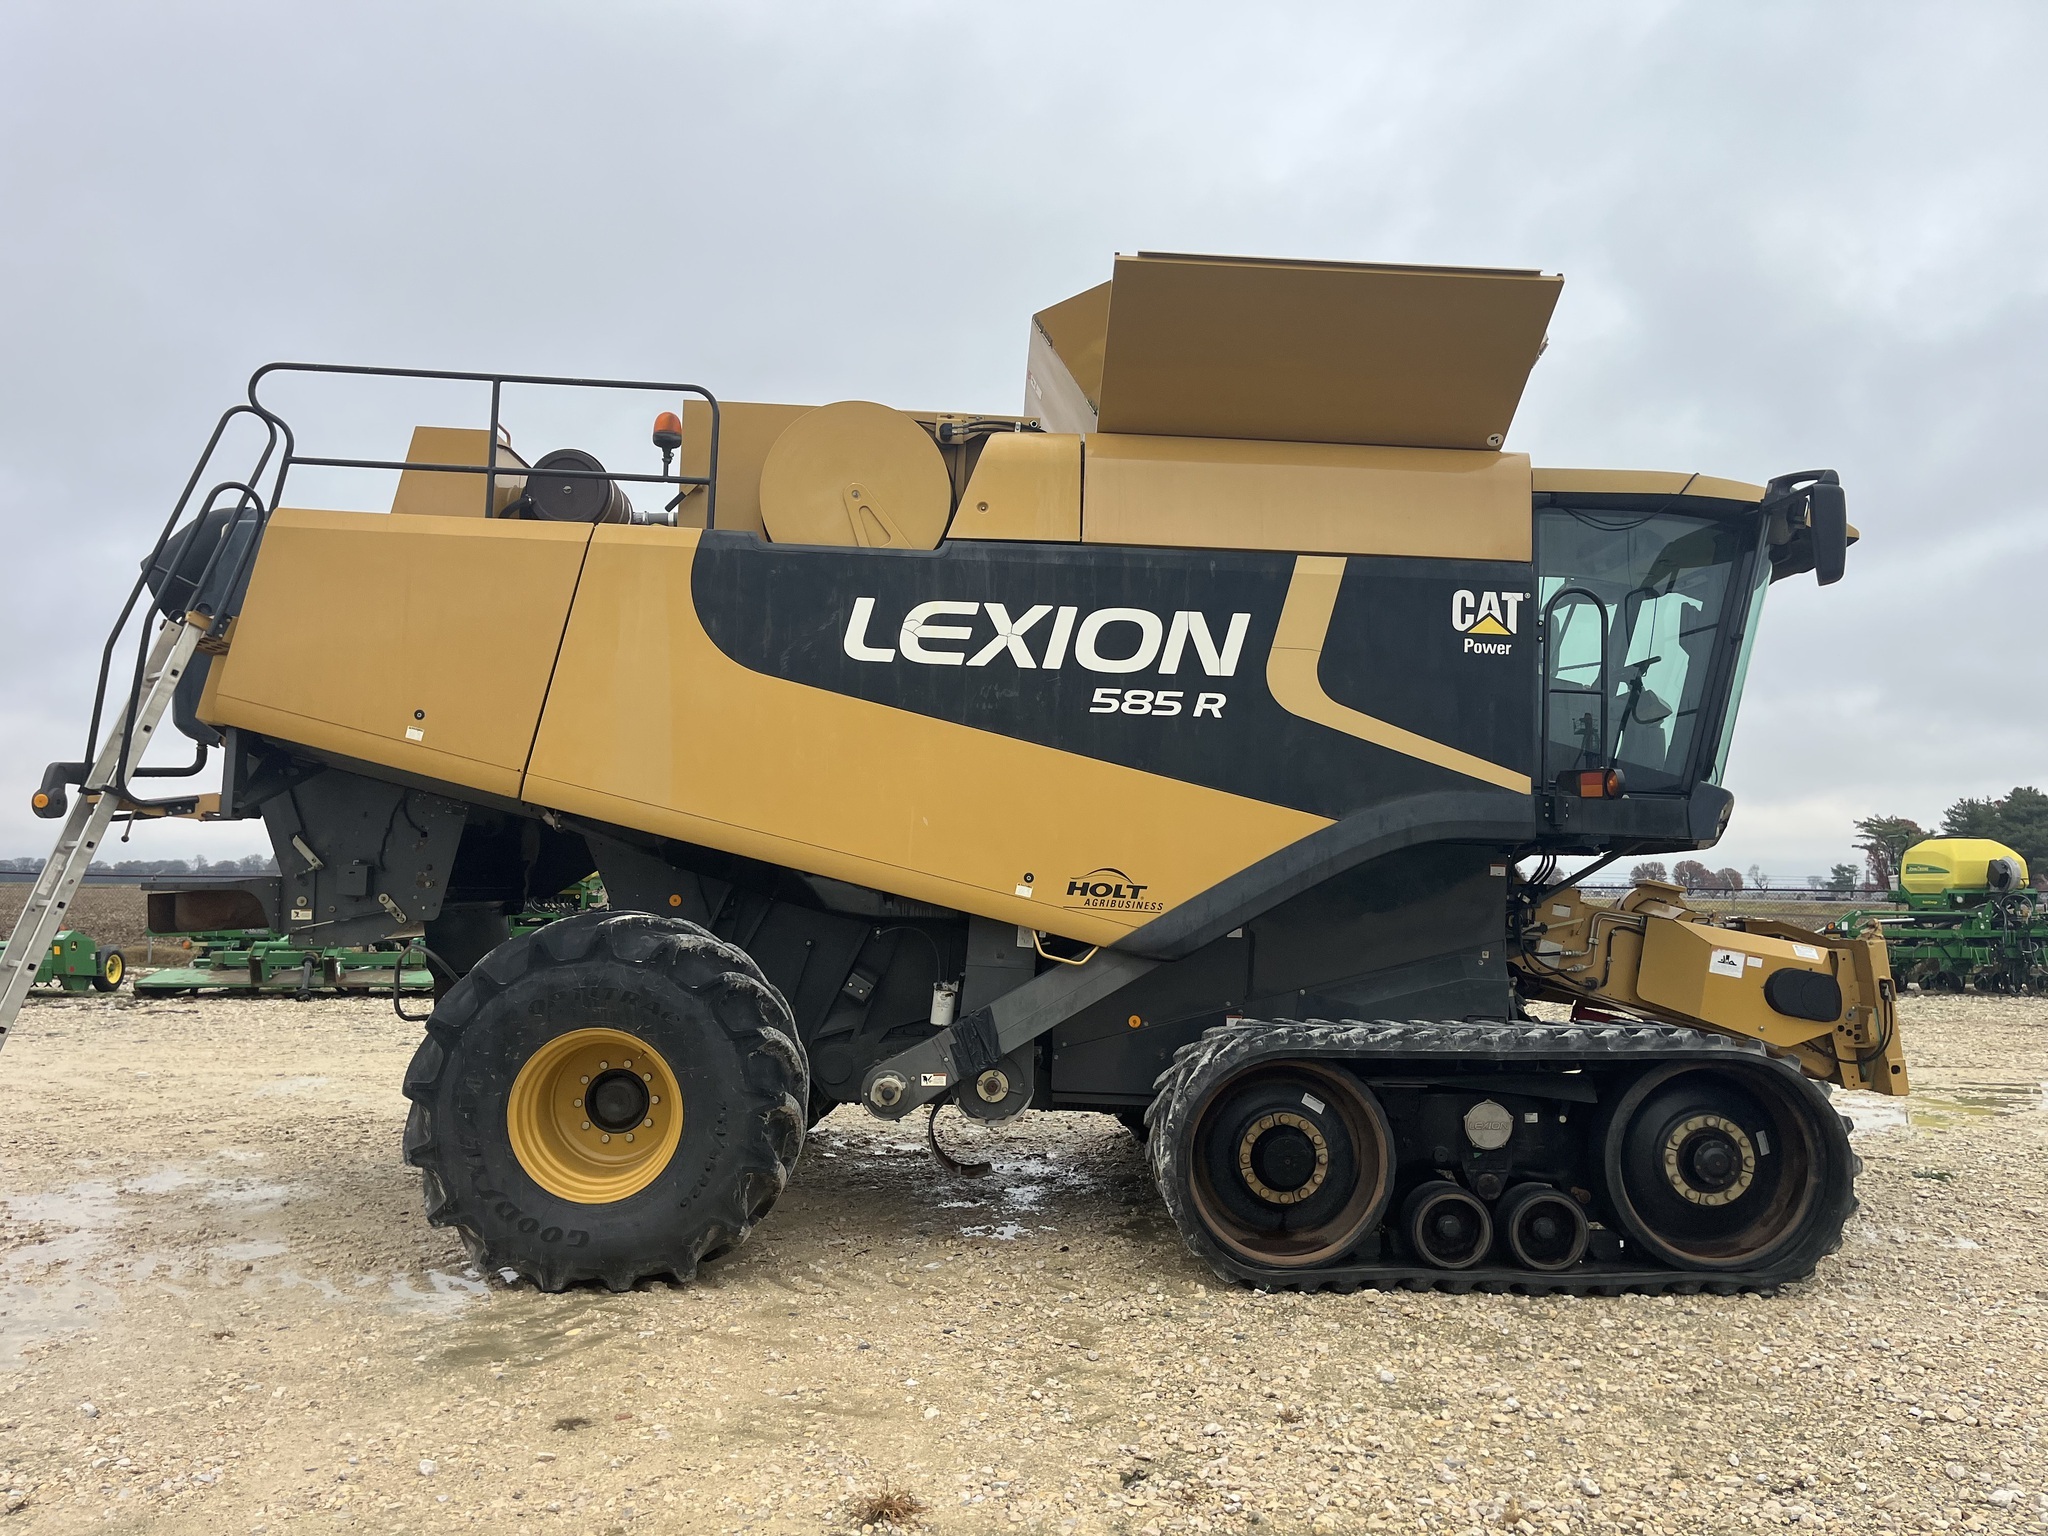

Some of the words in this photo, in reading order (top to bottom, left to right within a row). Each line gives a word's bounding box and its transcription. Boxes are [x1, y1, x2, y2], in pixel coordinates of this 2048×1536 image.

[1452, 589, 1523, 634] CAT
[843, 597, 1252, 677] LEXION
[1463, 638, 1512, 655] Power
[1089, 687, 1184, 717] 585
[1192, 691, 1227, 719] R
[1066, 881, 1148, 899] HOLT
[1083, 898, 1164, 911] AGRIBUSINESS
[1468, 1120, 1510, 1131] LEXION
